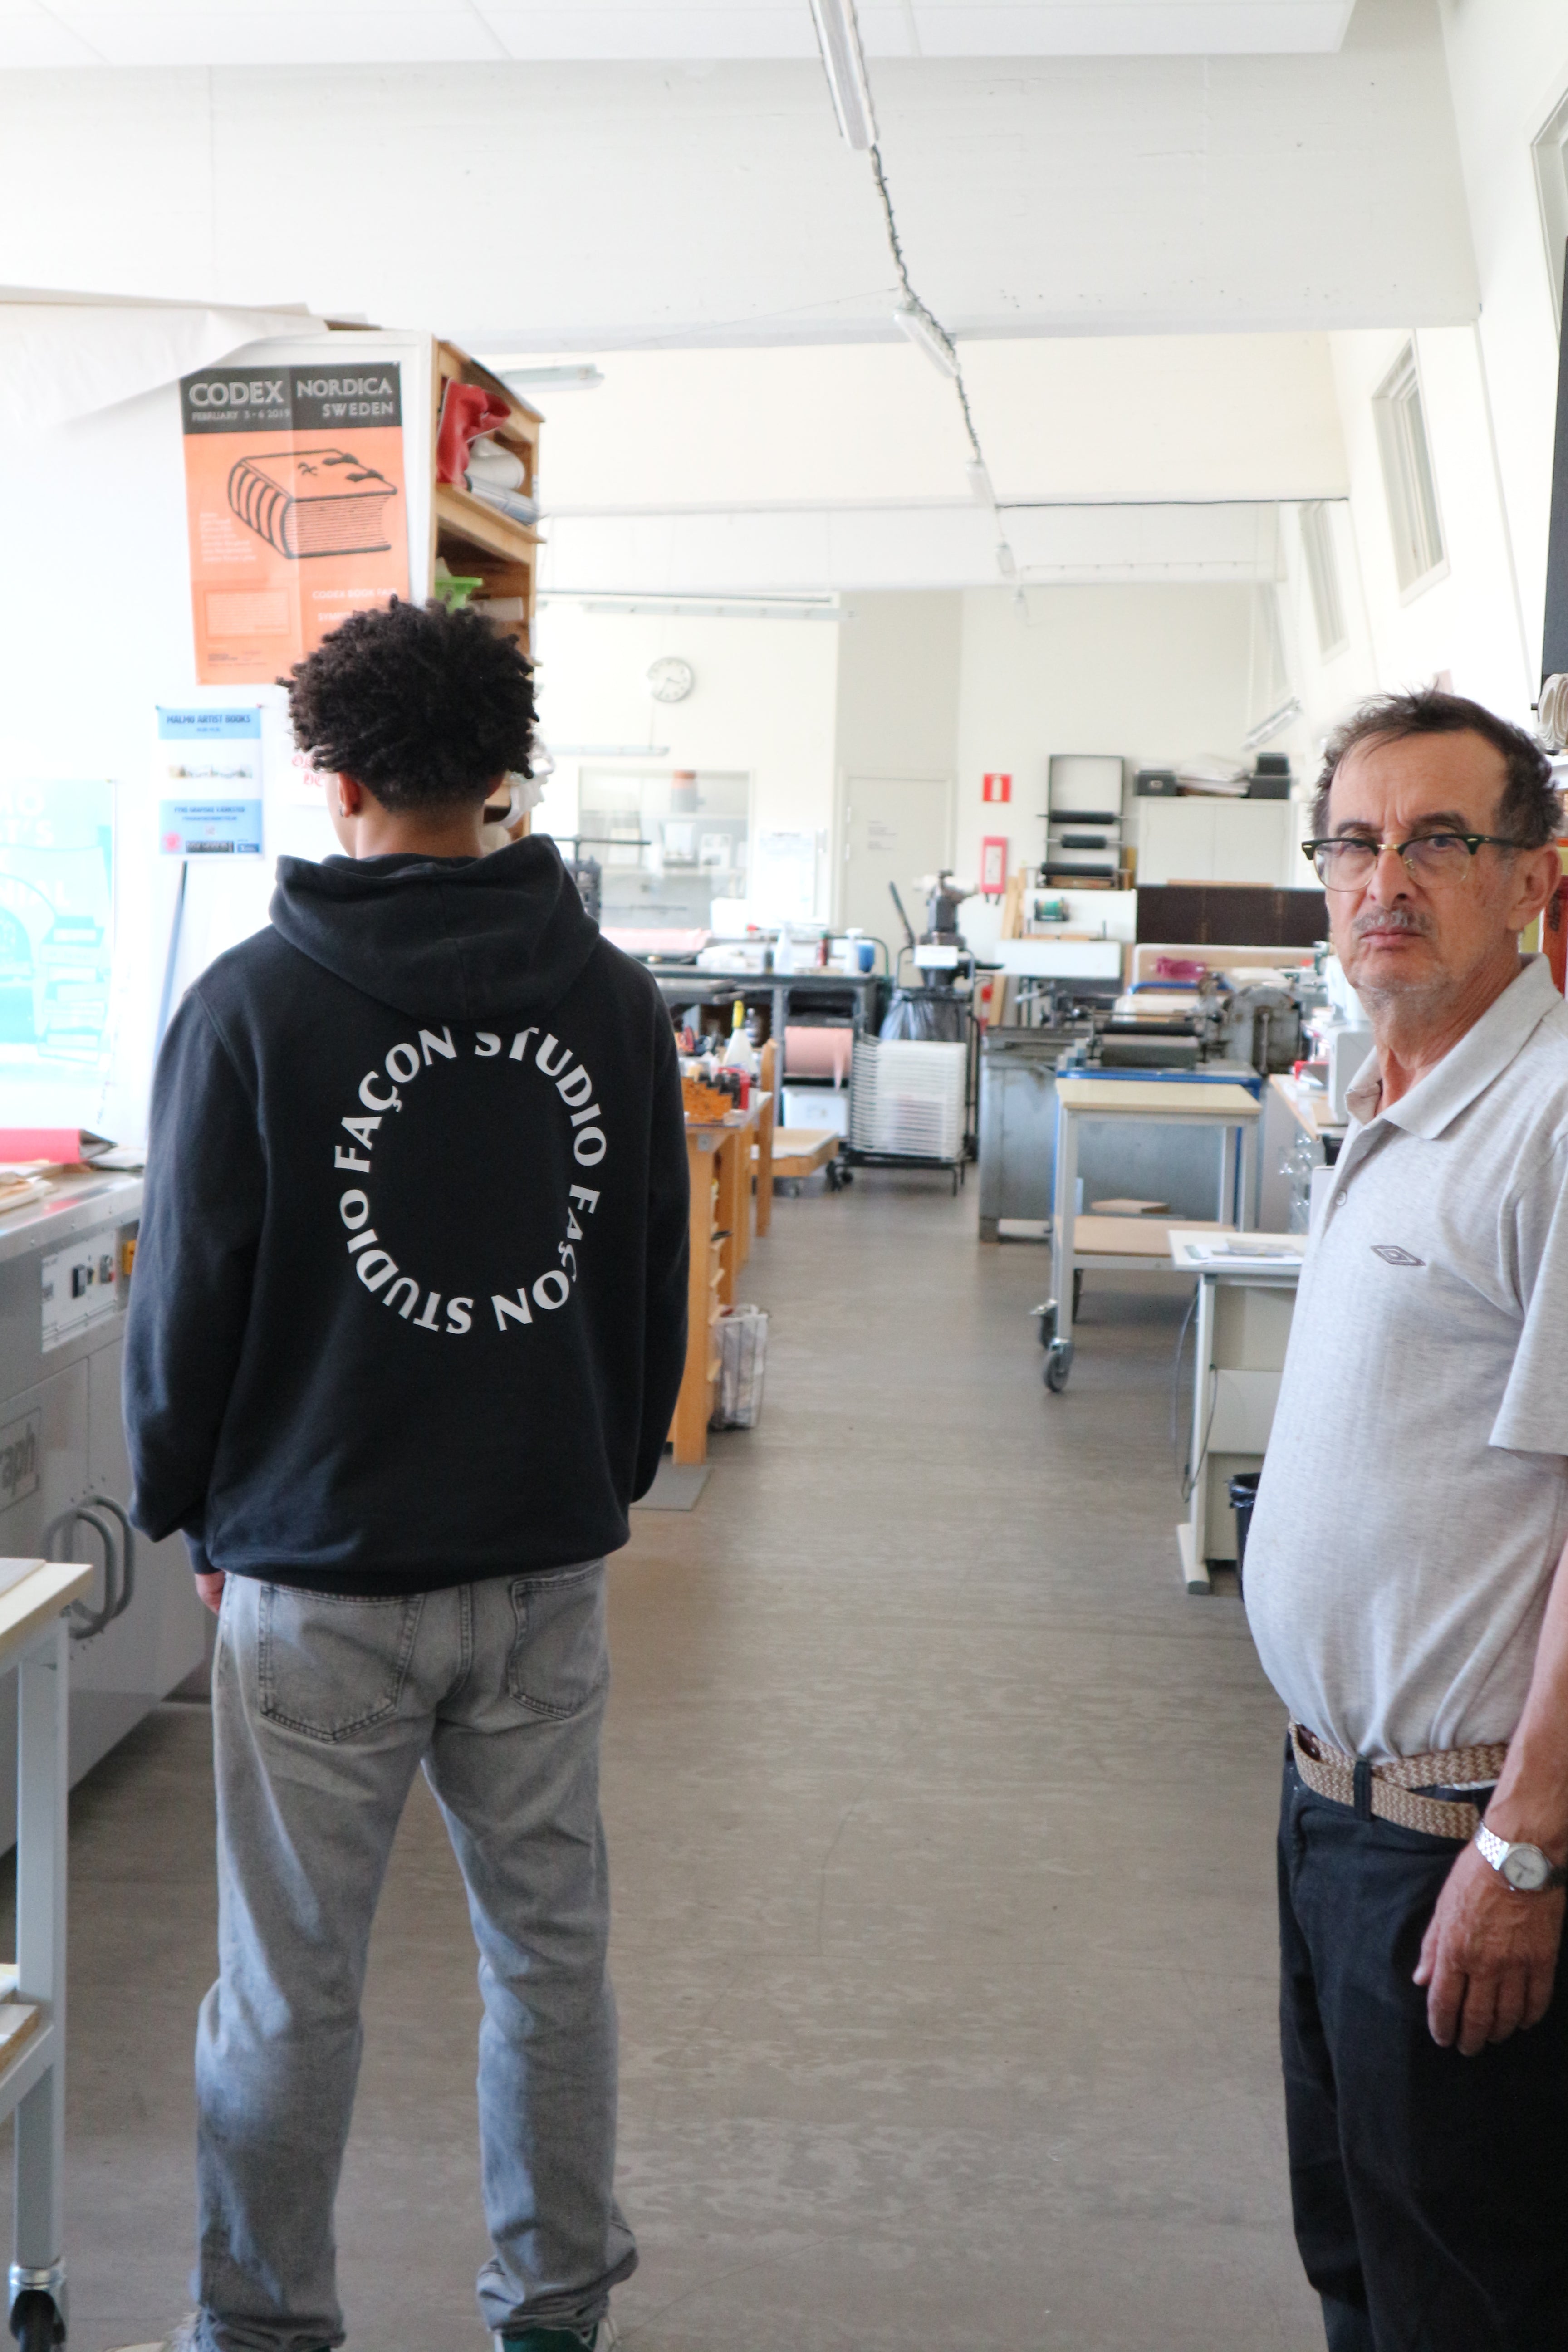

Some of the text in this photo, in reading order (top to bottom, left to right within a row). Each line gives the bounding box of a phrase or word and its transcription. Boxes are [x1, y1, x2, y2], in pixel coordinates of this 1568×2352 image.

[188, 377, 392, 407] CODEX NORDICA
[192, 410, 239, 421] FEBRUARY
[267, 408, 291, 418] 2019
[322, 401, 394, 417] SWEDEN
[312, 589, 346, 599] CODEX
[347, 588, 375, 598] BOOK
[333, 1025, 474, 1334] STUDIO FAÇON
[474, 1026, 607, 1332] STUDIO FAÇON
